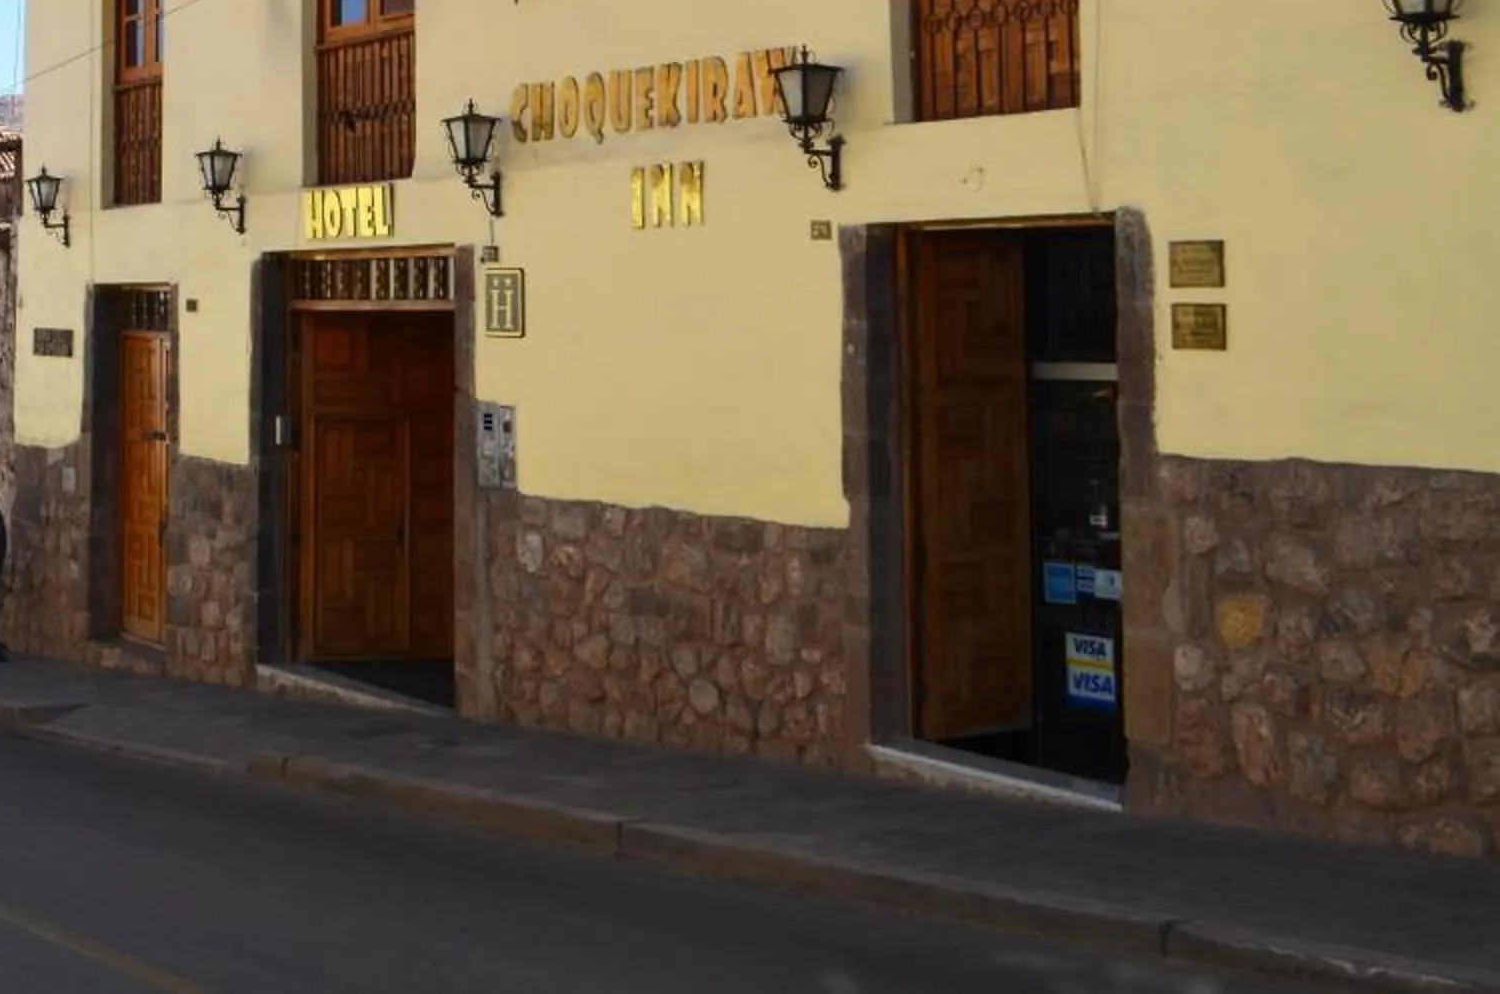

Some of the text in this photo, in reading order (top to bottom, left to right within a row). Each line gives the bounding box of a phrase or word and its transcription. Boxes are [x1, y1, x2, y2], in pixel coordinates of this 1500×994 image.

[303, 183, 395, 239] HOTEL
[630, 161, 704, 230] INN
[1073, 637, 1107, 657] VISA
[1073, 671, 1114, 694] VISA
